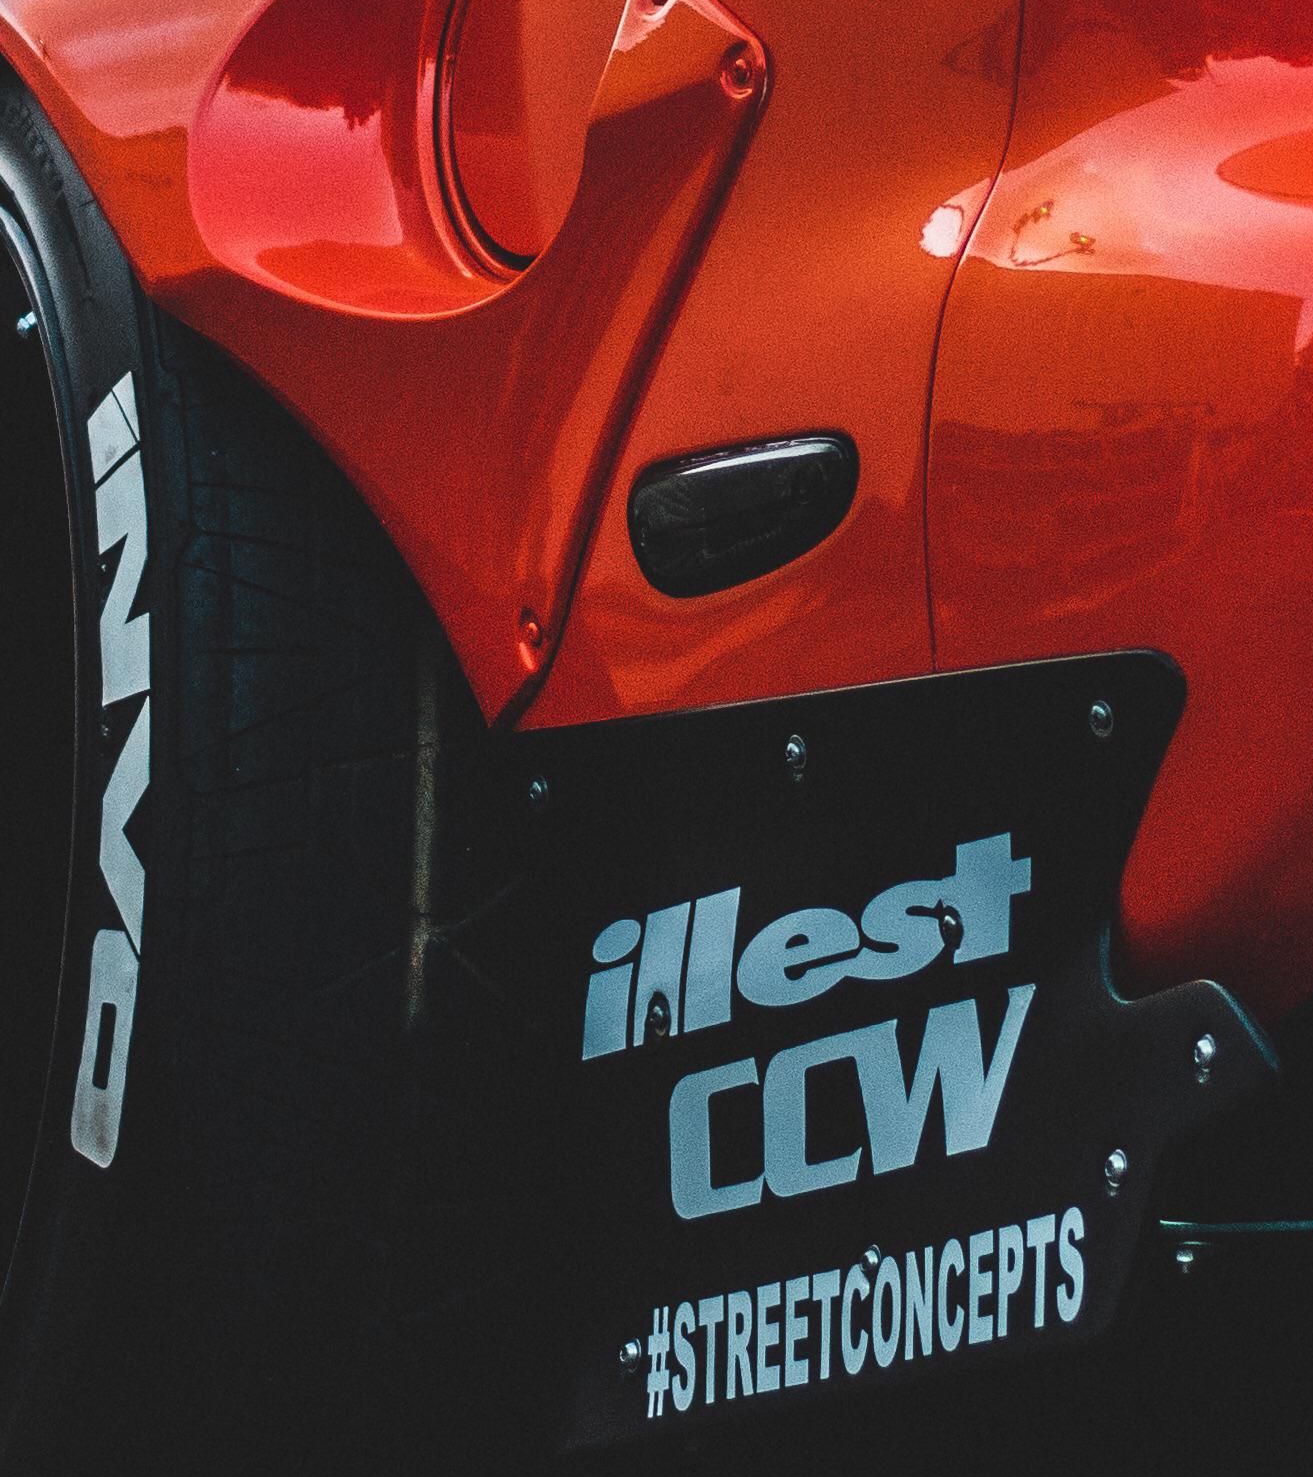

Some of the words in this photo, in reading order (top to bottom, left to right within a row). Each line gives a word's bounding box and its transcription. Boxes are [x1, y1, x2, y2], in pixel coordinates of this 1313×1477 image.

[582, 833, 1032, 1060] illest
[669, 984, 1036, 1220] CCW
[647, 1207, 1085, 1419] #STREETCONCEPTS
